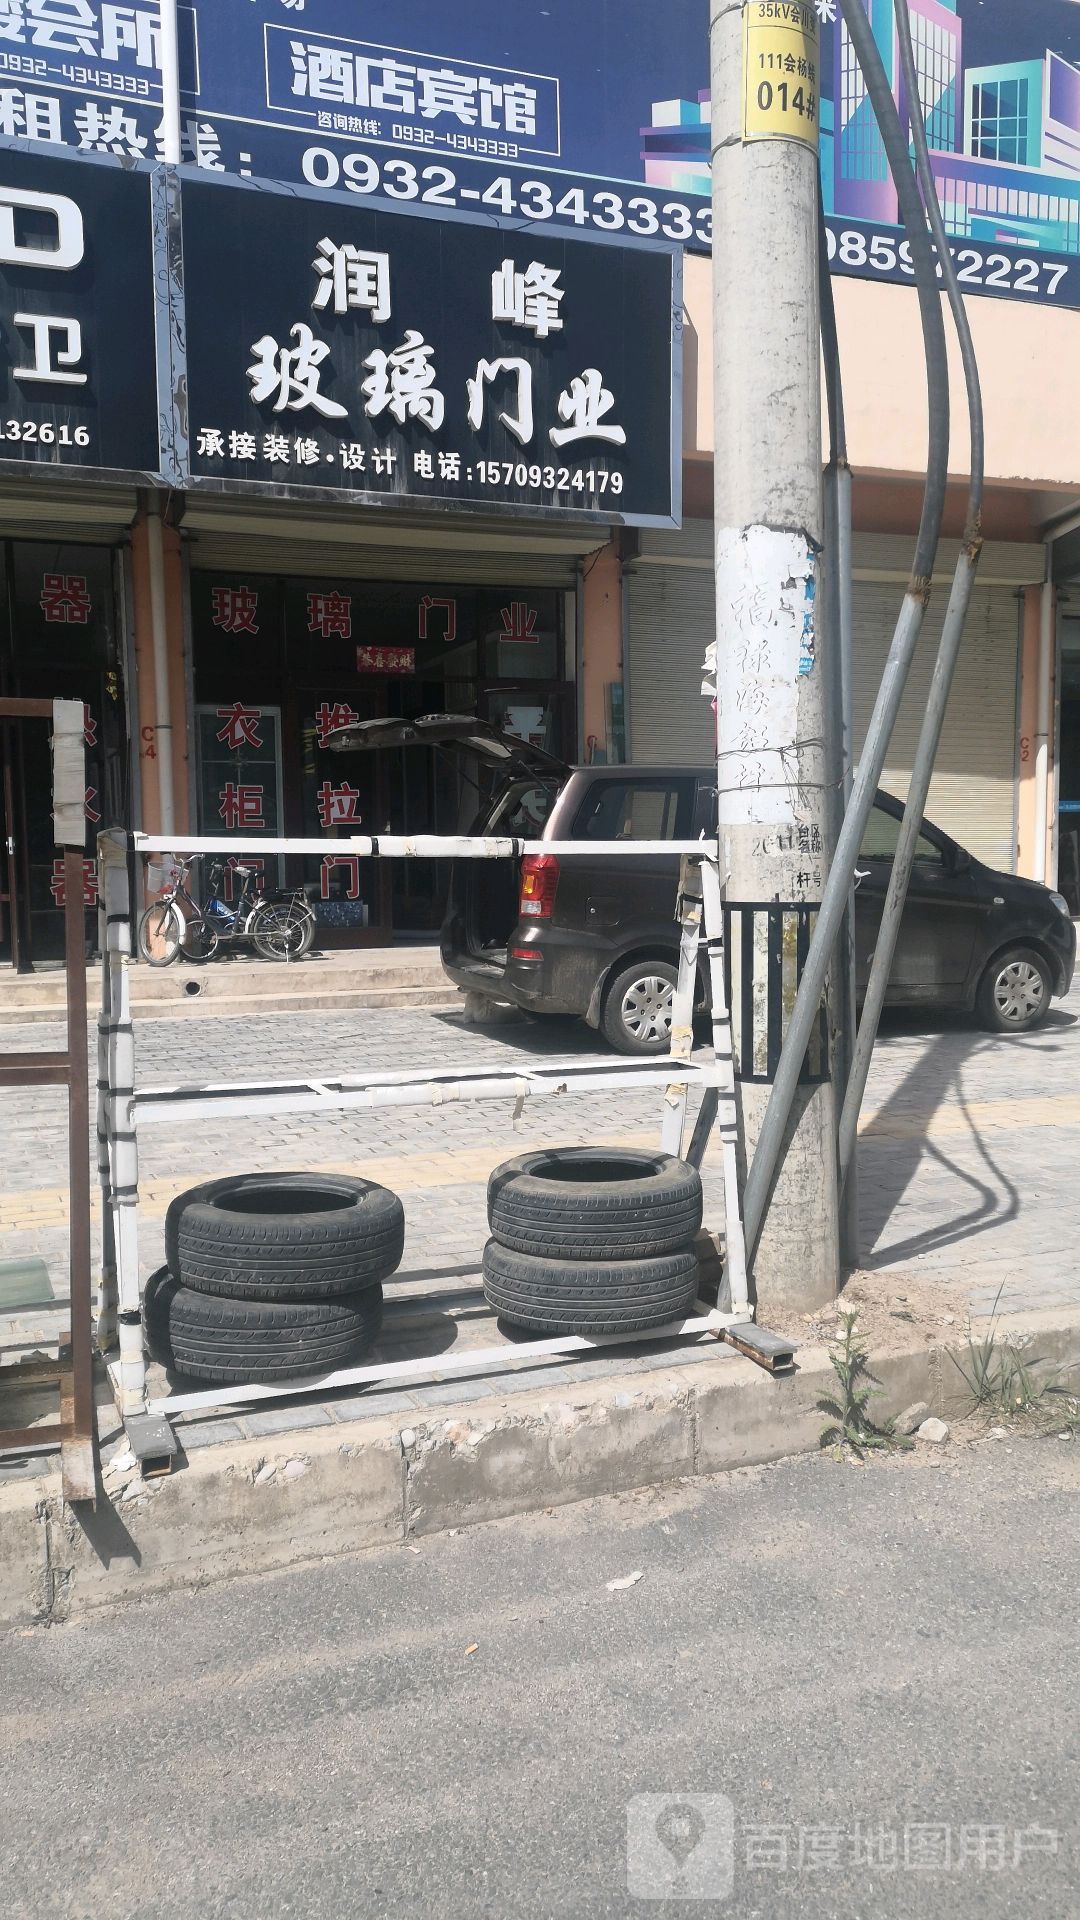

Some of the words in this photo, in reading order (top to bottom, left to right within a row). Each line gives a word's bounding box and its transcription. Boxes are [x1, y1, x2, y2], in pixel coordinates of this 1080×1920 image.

[290, 40, 536, 136] 酒店宾馆
[757, 80, 816, 122] 014#
[391, 123, 519, 158] 0932-4343333
[311, 236, 565, 339] 润峰
[13, 312, 88, 385] 卫
[246, 322, 627, 450] 玻璃门业
[0, 419, 91, 447] 32616
[212, 585, 539, 643] 玻璃门业
